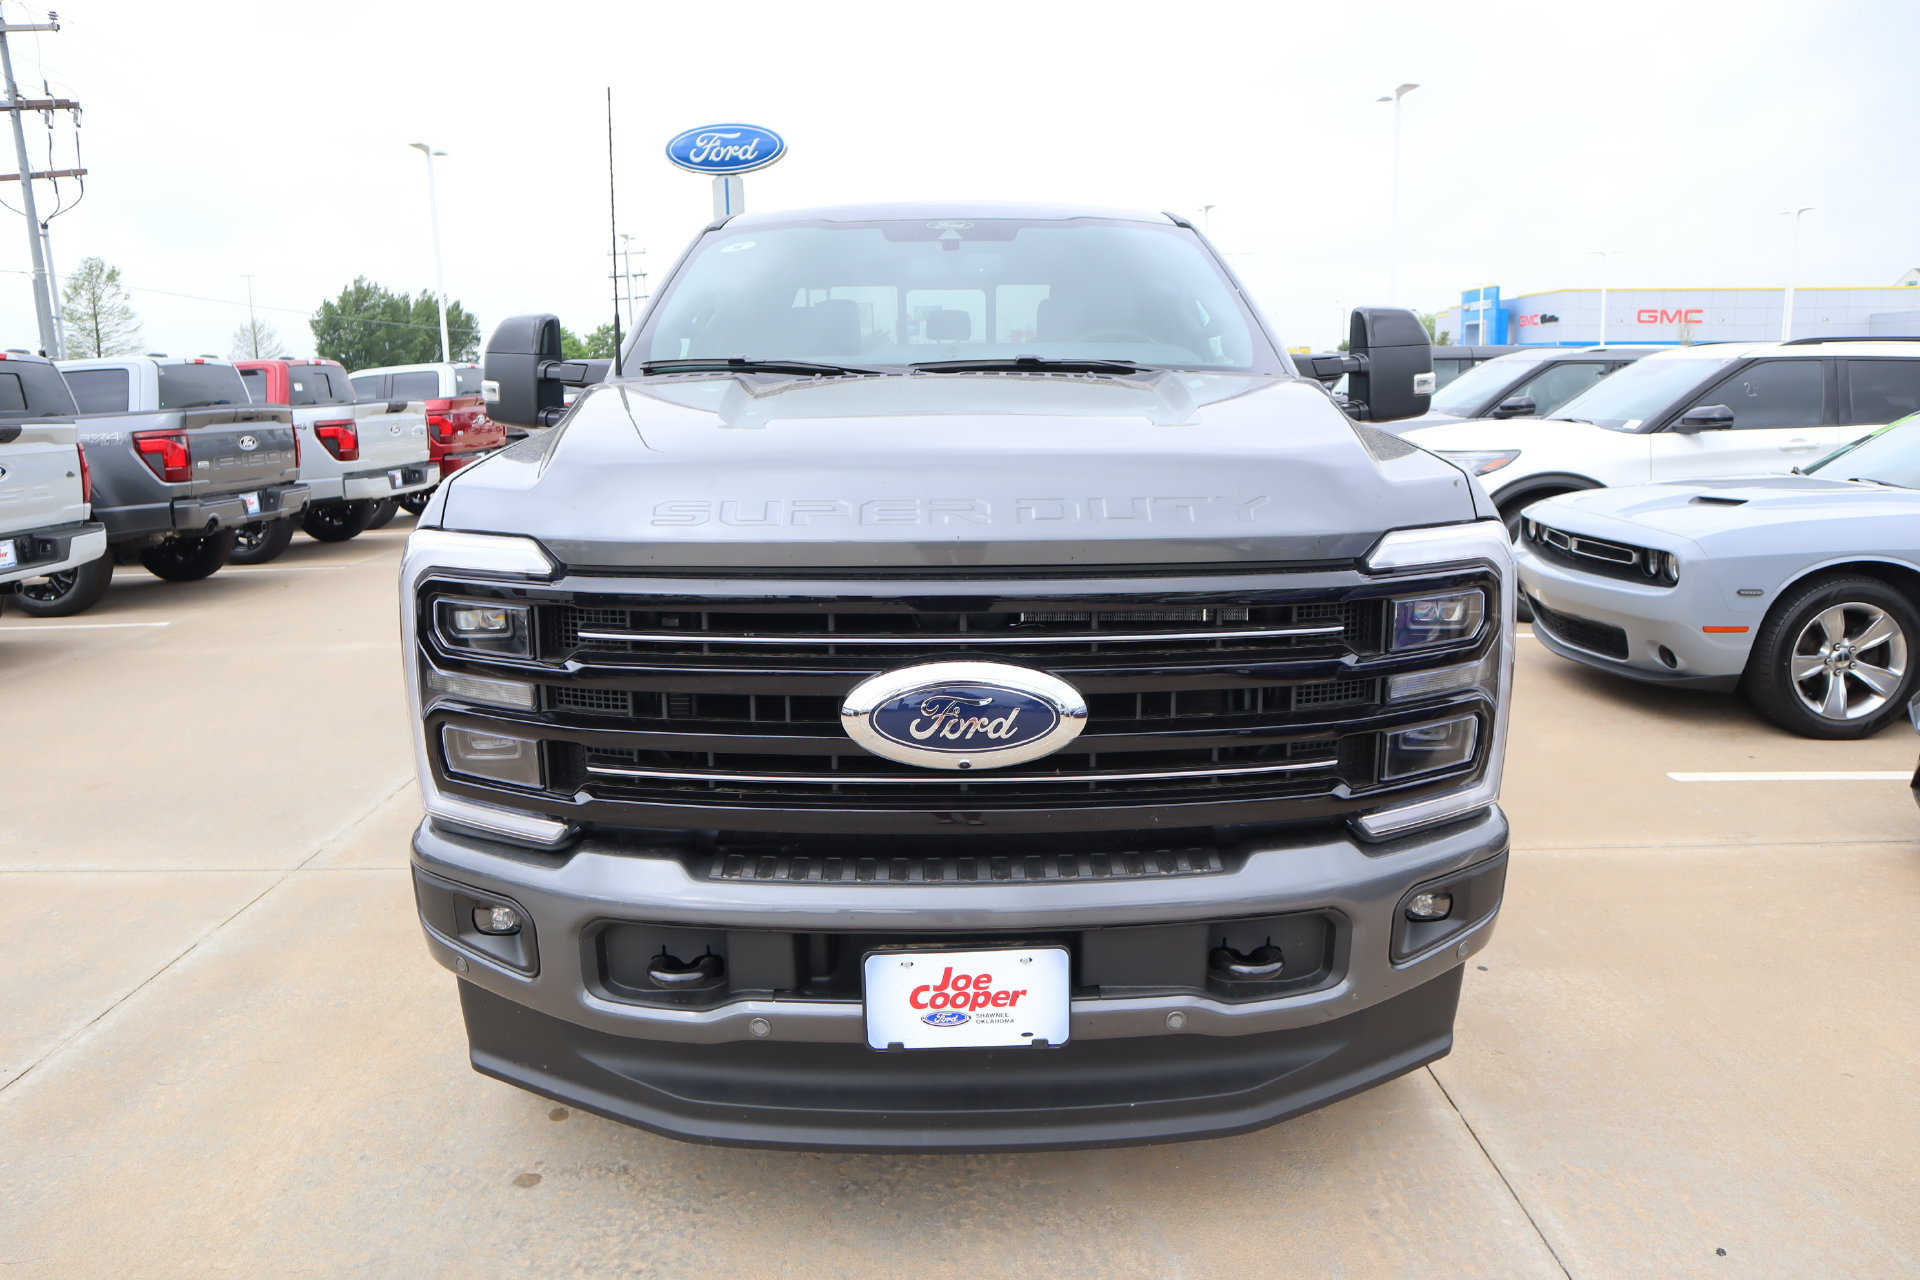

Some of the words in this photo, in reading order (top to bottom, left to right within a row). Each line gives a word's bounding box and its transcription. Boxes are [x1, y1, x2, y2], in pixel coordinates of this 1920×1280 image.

[689, 132, 760, 163] Ford
[1636, 309, 1704, 324] GMC
[650, 499, 991, 527] SUPER
[1015, 496, 1271, 526] DUTY
[909, 695, 1021, 740] Ford
[932, 967, 993, 992] Joe
[909, 985, 1027, 1012] Cooper
[934, 1013, 959, 1023] Ford
